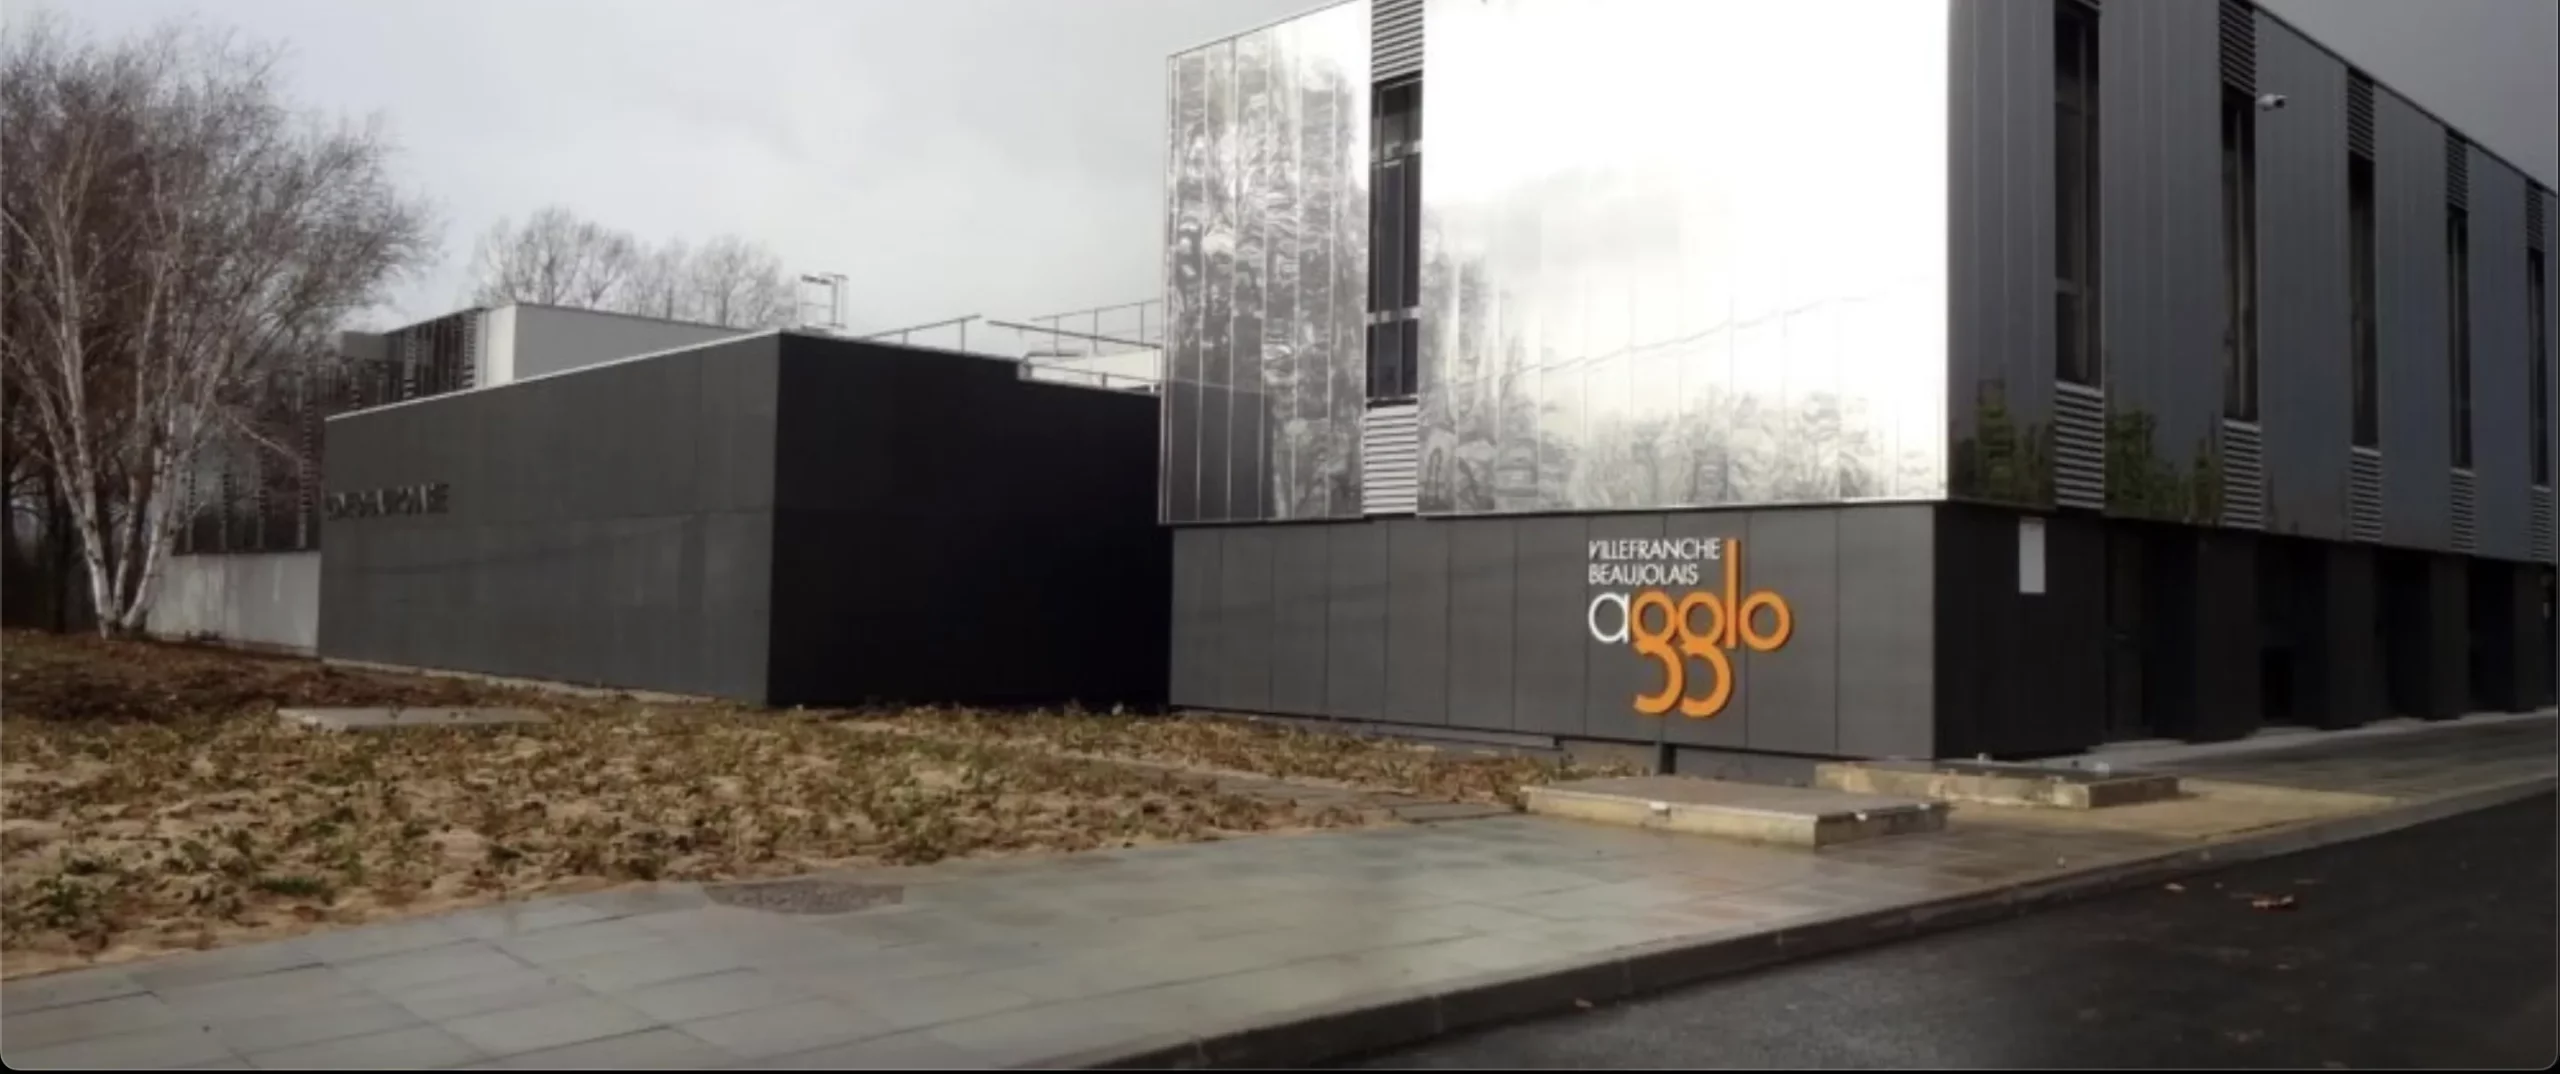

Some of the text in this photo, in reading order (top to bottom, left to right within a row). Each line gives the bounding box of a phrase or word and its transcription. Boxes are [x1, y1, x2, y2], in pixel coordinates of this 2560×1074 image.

[1588, 537, 1721, 560] VILLEFRANCHE
[1588, 563, 1699, 585] BEAUJOLAIS
[1588, 538, 1792, 718] agglo
